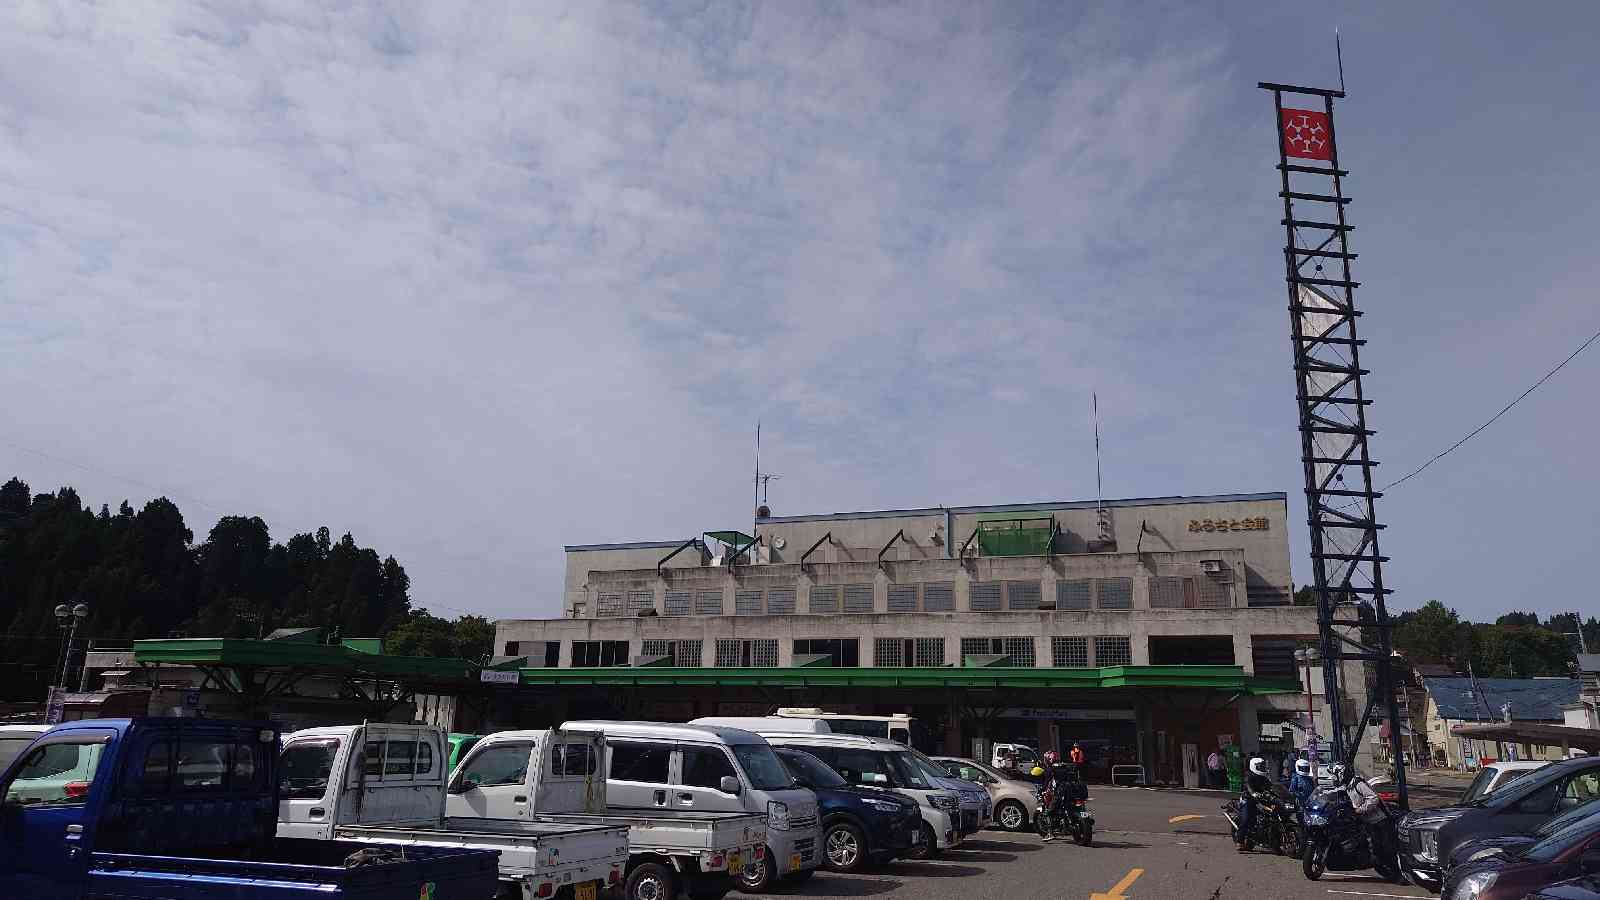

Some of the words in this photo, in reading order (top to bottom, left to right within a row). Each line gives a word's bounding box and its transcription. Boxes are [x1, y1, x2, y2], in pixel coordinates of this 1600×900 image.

[1188, 516, 1269, 533] ふるさと会館
